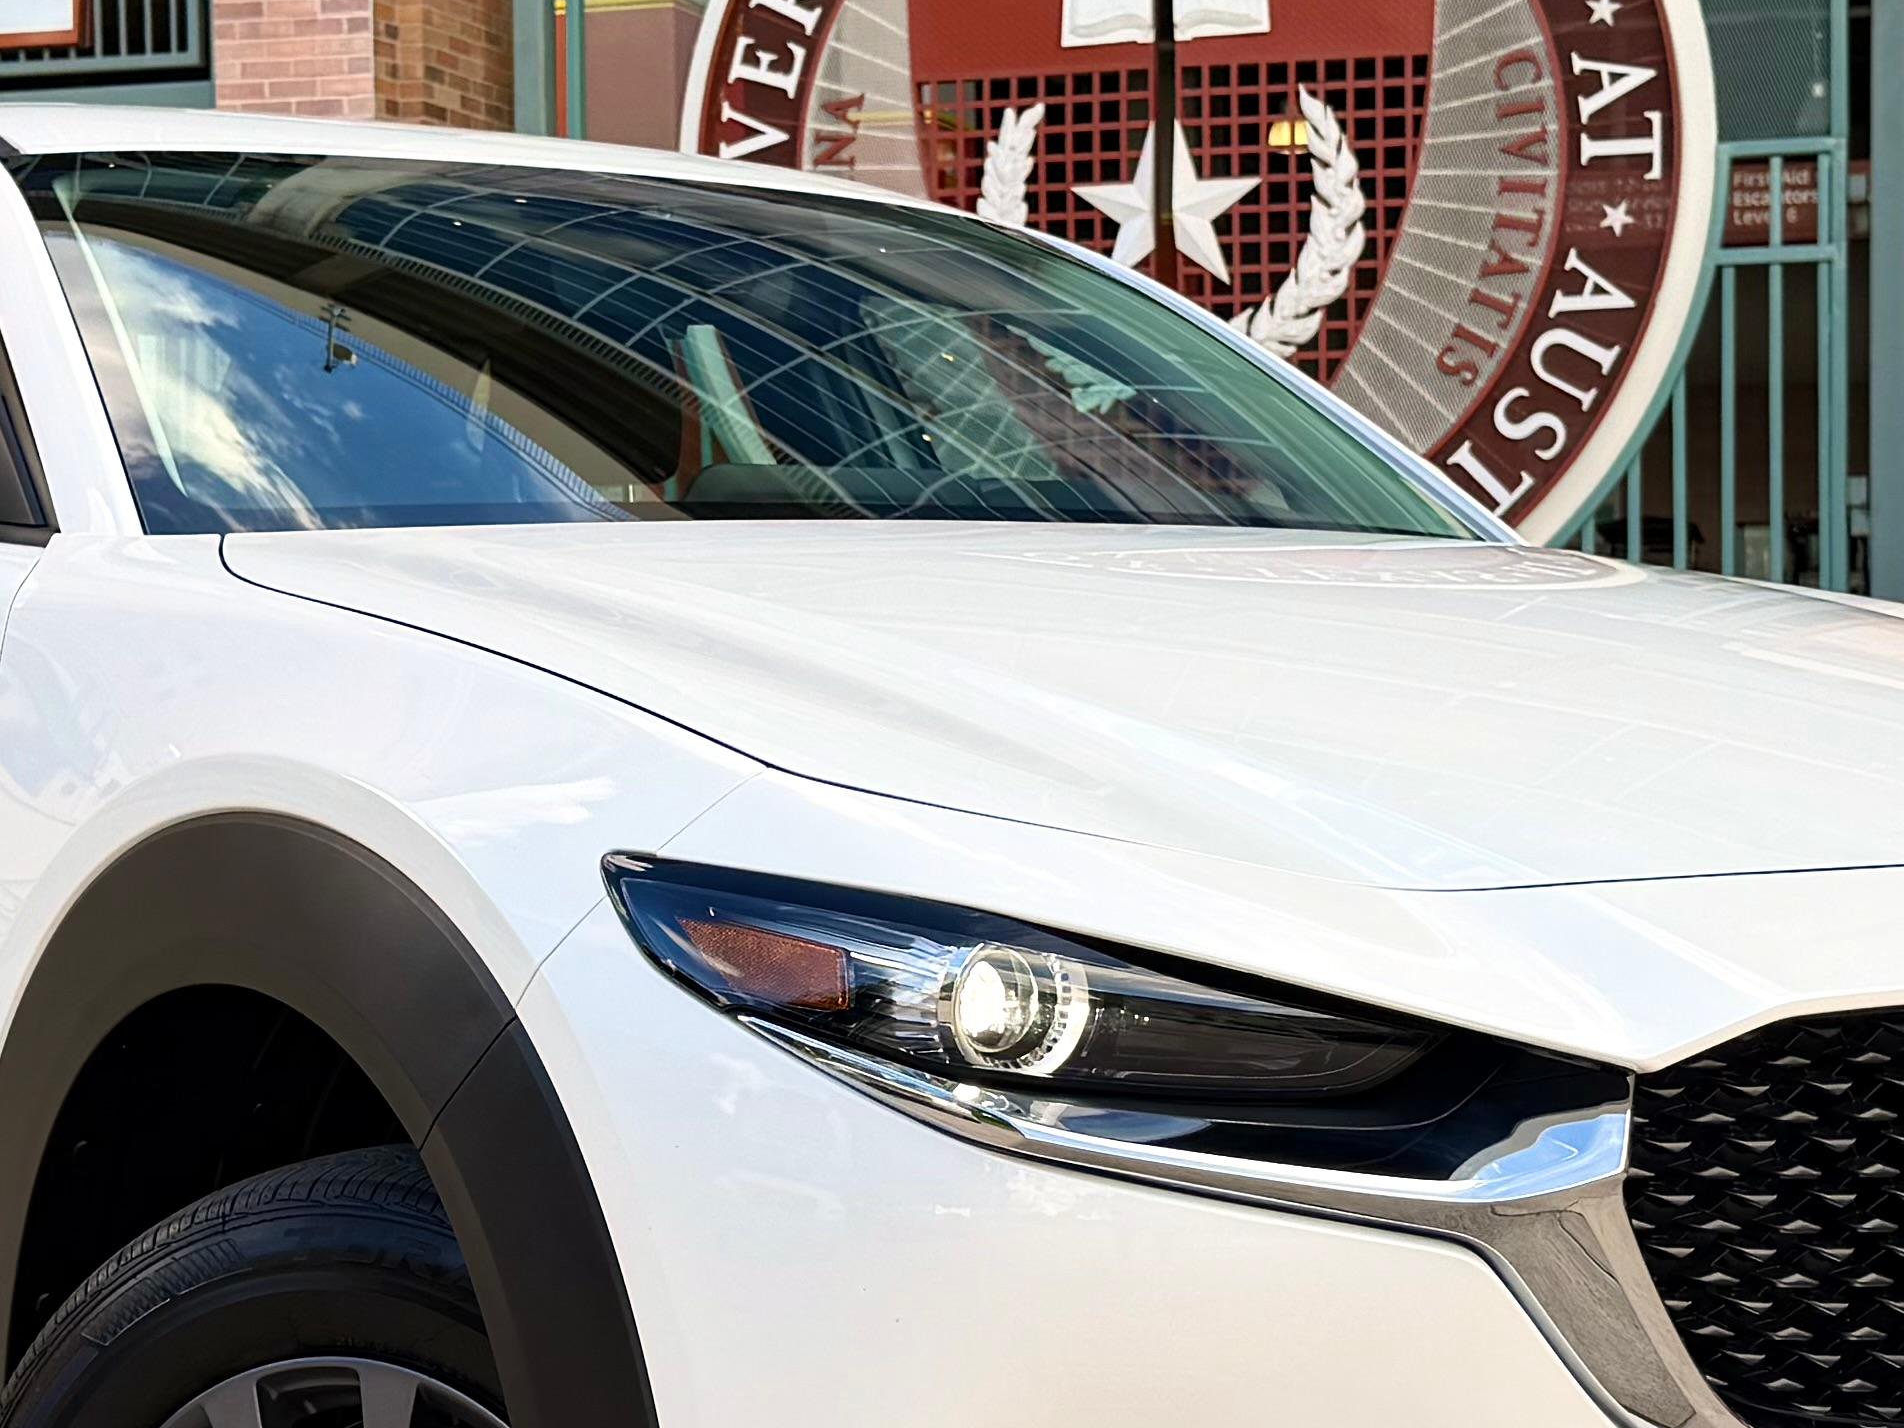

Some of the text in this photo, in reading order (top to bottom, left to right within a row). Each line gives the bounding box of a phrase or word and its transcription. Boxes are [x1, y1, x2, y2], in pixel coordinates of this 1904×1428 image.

[1571, 51, 1663, 181] AT
[1436, 49, 1548, 387] CIVITATIS
[1733, 190, 1819, 206] Escators
[1733, 209, 1773, 226] Leve
